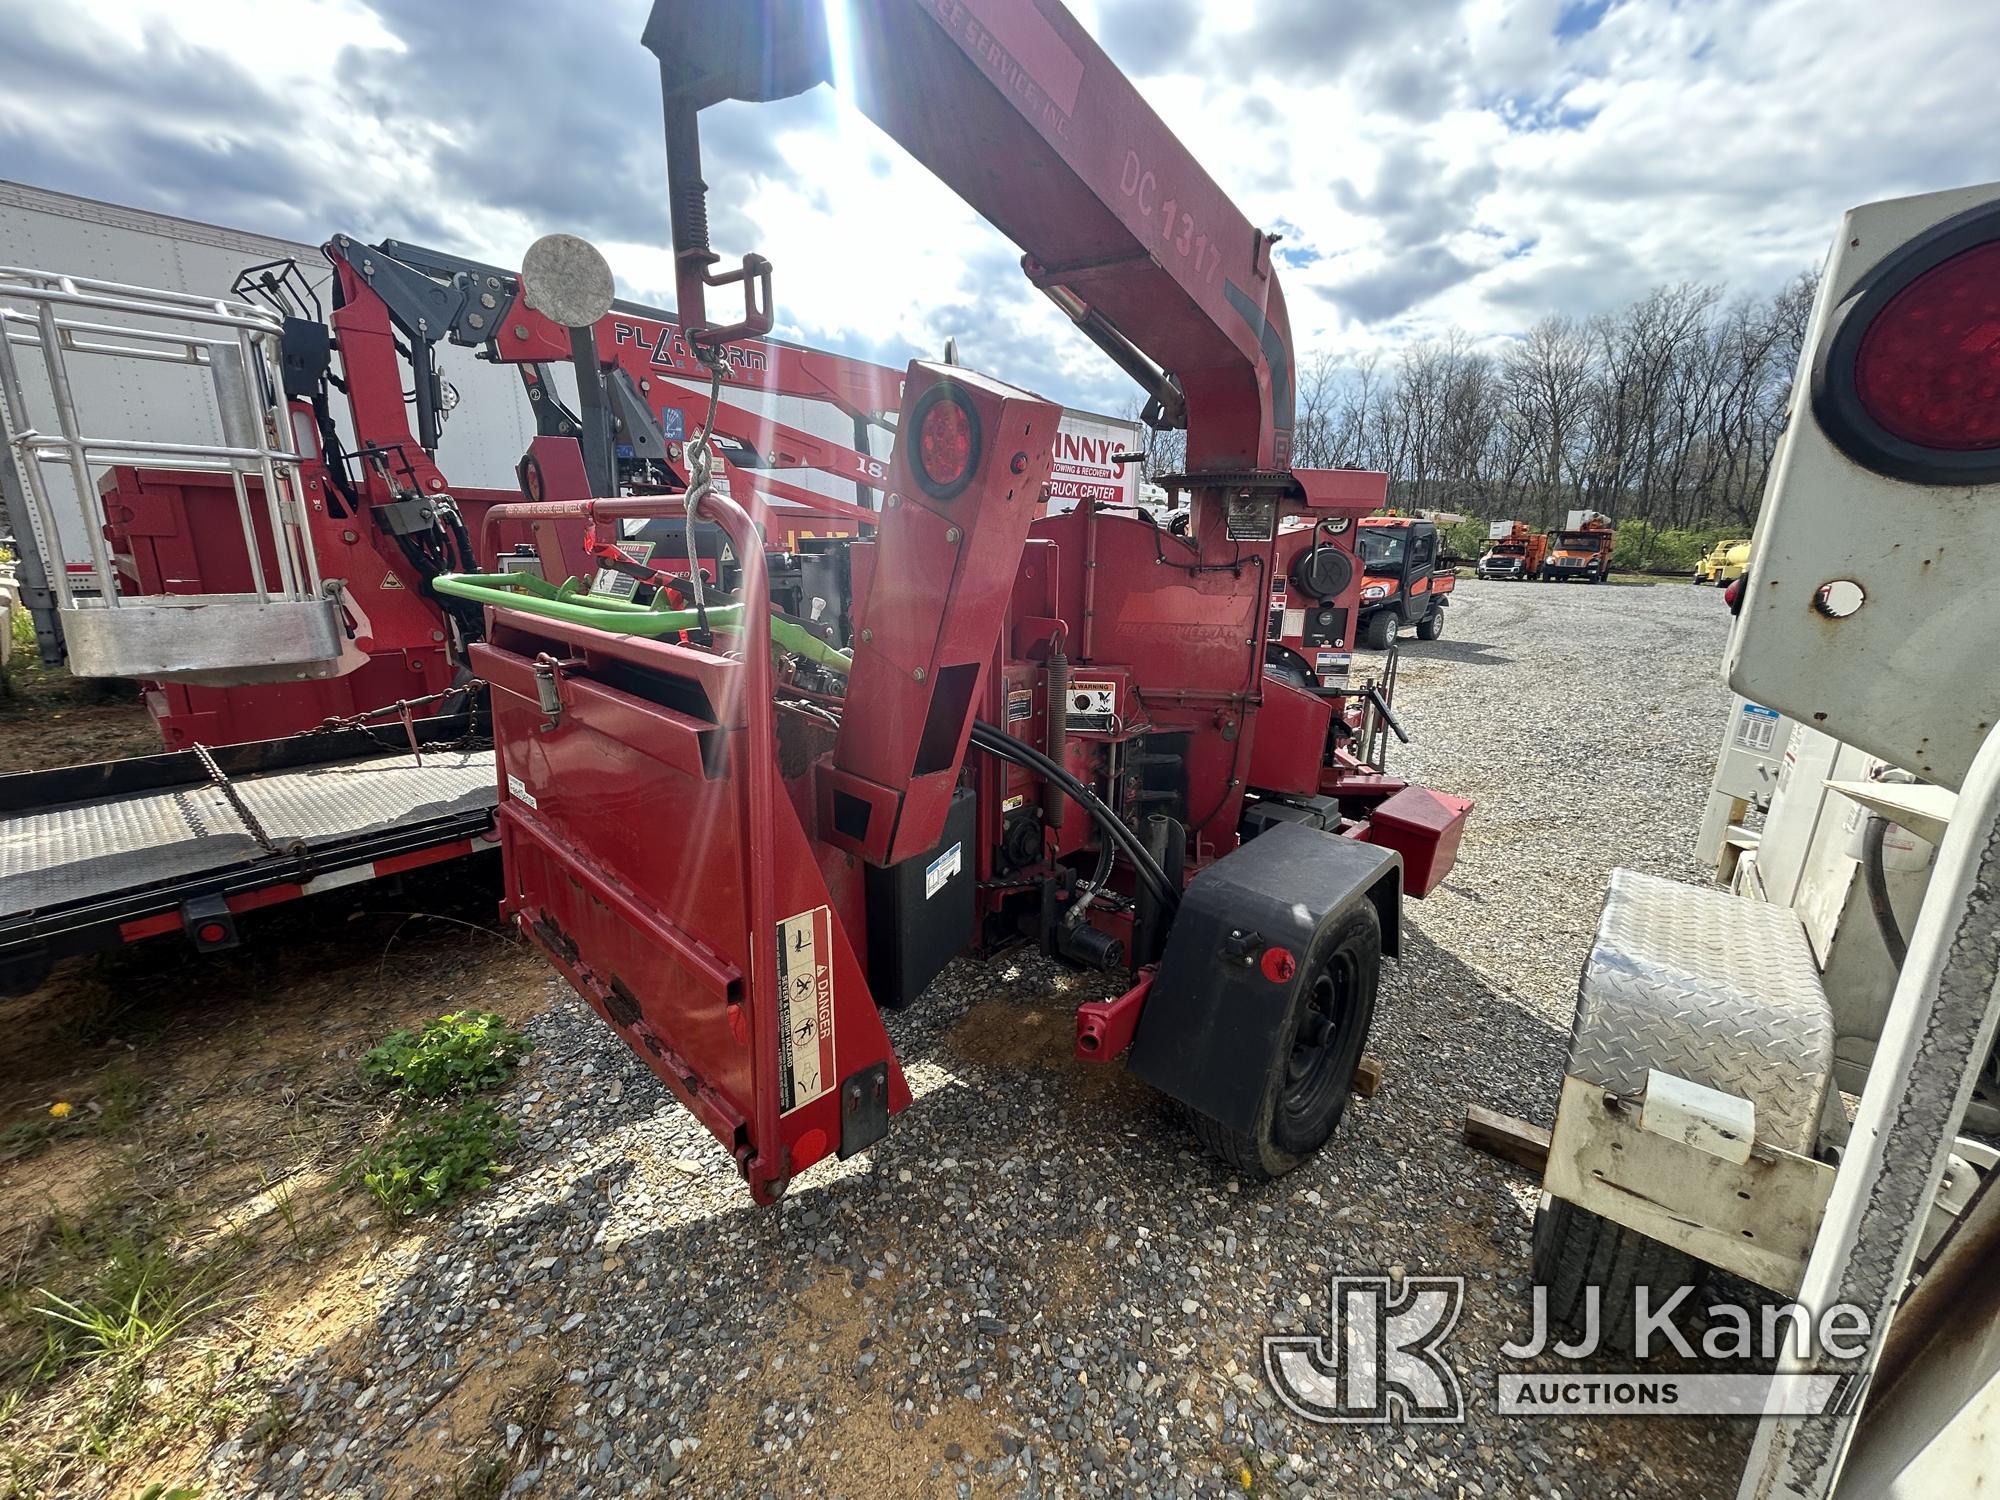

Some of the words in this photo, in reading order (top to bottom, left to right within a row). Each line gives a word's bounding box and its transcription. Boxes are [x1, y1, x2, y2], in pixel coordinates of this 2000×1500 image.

[1042, 101, 1069, 141] INC.
[1119, 150, 1157, 216] DC
[1162, 198, 1222, 284] 1317
[1053, 463, 1076, 474] TOWING
[1076, 466, 1081, 474] &
[1081, 466, 1110, 478] RECOVERY
[1054, 432, 1126, 480] INNY'S
[1050, 481, 1079, 497] RUCK
[1080, 484, 1115, 500] CENTER
[781, 974, 789, 1000] SEVER
[783, 1001, 789, 1009] &
[818, 978, 832, 1040] DANGER
[785, 1038, 793, 1068] HAZARD
